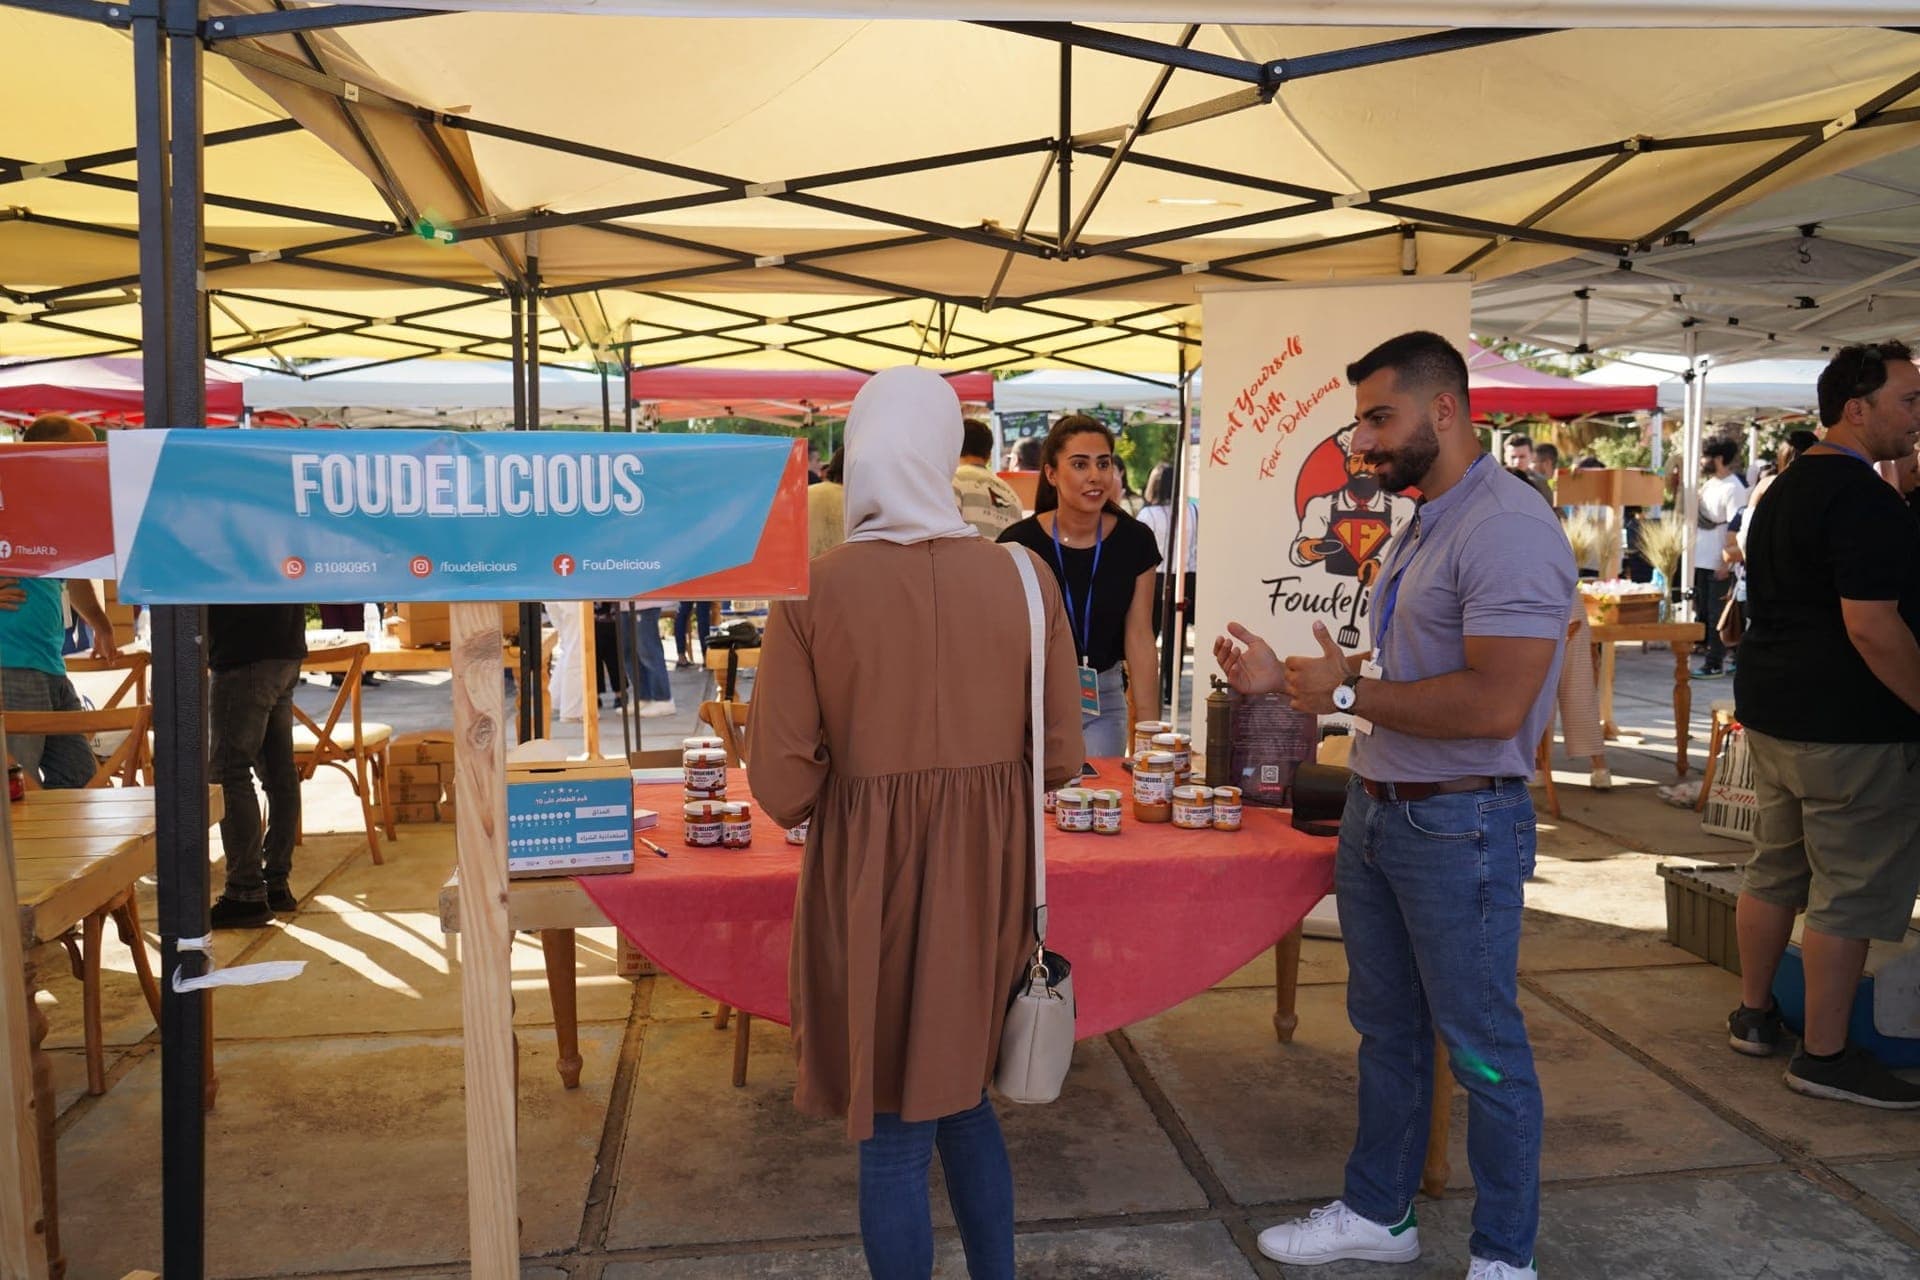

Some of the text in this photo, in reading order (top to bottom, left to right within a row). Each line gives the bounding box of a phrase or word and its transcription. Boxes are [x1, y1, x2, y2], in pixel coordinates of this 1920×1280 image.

[1209, 334, 1303, 468] Treat Yourself
[1253, 391, 1287, 433] With
[291, 453, 645, 518] FOUDELICIOUS
[314, 562, 377, 573] 81080951
[440, 560, 517, 573] /foudelicious
[582, 558, 661, 571] FouDelicious
[1261, 576, 1370, 619] Foudeli
